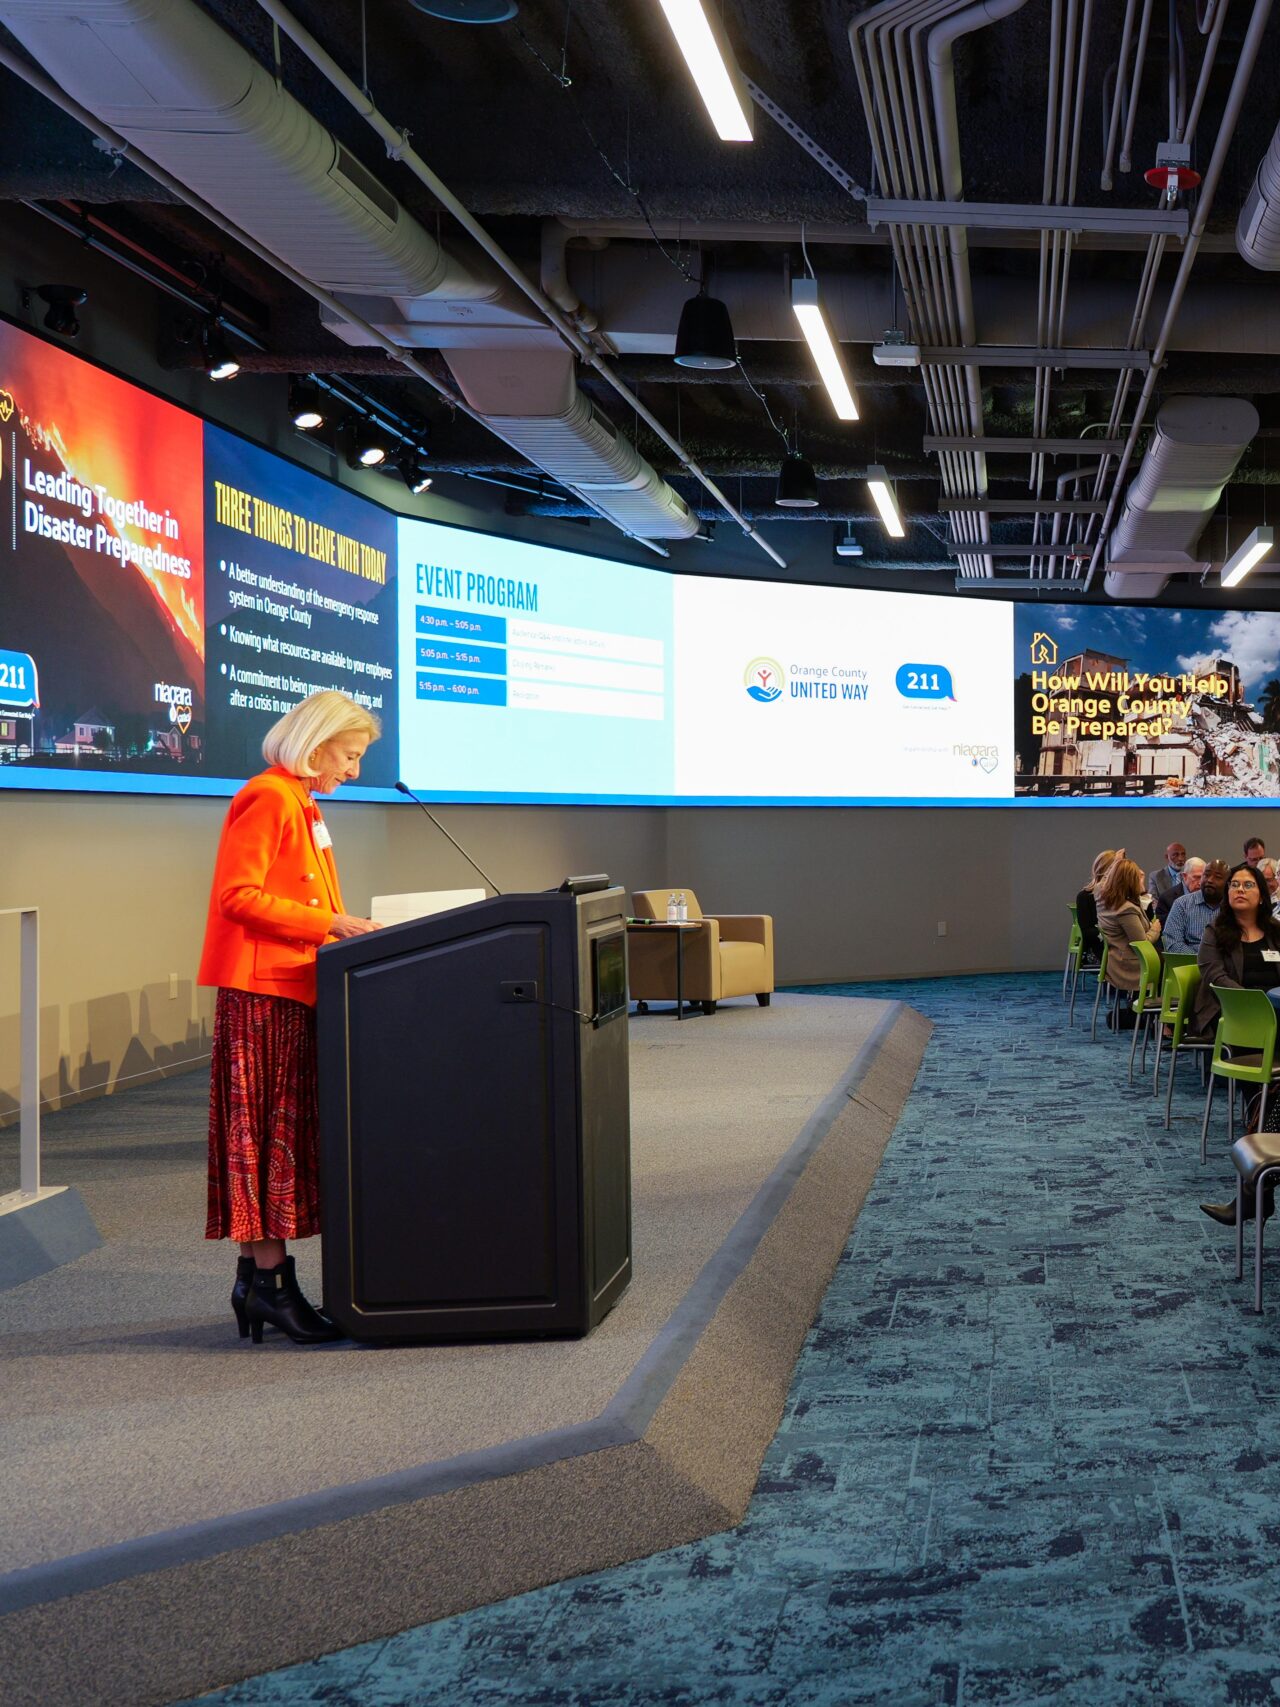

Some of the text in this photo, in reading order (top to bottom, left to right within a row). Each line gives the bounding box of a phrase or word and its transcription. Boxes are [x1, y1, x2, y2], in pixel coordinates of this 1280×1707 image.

[24, 458, 92, 518] Leading
[95, 484, 163, 534] Together
[165, 510, 179, 540] in
[24, 500, 191, 579] Disaster Preparedness
[214, 480, 387, 586] THREE THINGS TO LEAVE WITH TODAY
[229, 562, 379, 625] A better understanding of the emergency response
[416, 563, 538, 612] EVENT PROGRAM
[229, 590, 312, 629] system in Orange County
[229, 625, 393, 681] Knowing what resources are available to your employees
[0, 663, 26, 690] 211
[790, 664, 868, 680] Orange County
[906, 672, 940, 691] 211
[1031, 670, 1229, 698] How Will You Help
[155, 681, 192, 708] niagara
[229, 664, 236, 682] A
[237, 668, 282, 691] commitment
[282, 675, 288, 692] to
[289, 676, 308, 699] being
[372, 694, 383, 709] and
[790, 681, 869, 701] UNITED WAY
[230, 689, 247, 707] after
[248, 695, 254, 708] a
[254, 693, 272, 711] crisis
[272, 696, 280, 713] in
[1031, 692, 1193, 720] Orange County
[1031, 716, 1173, 741] Be Prepared?
[952, 743, 999, 759] niagara
